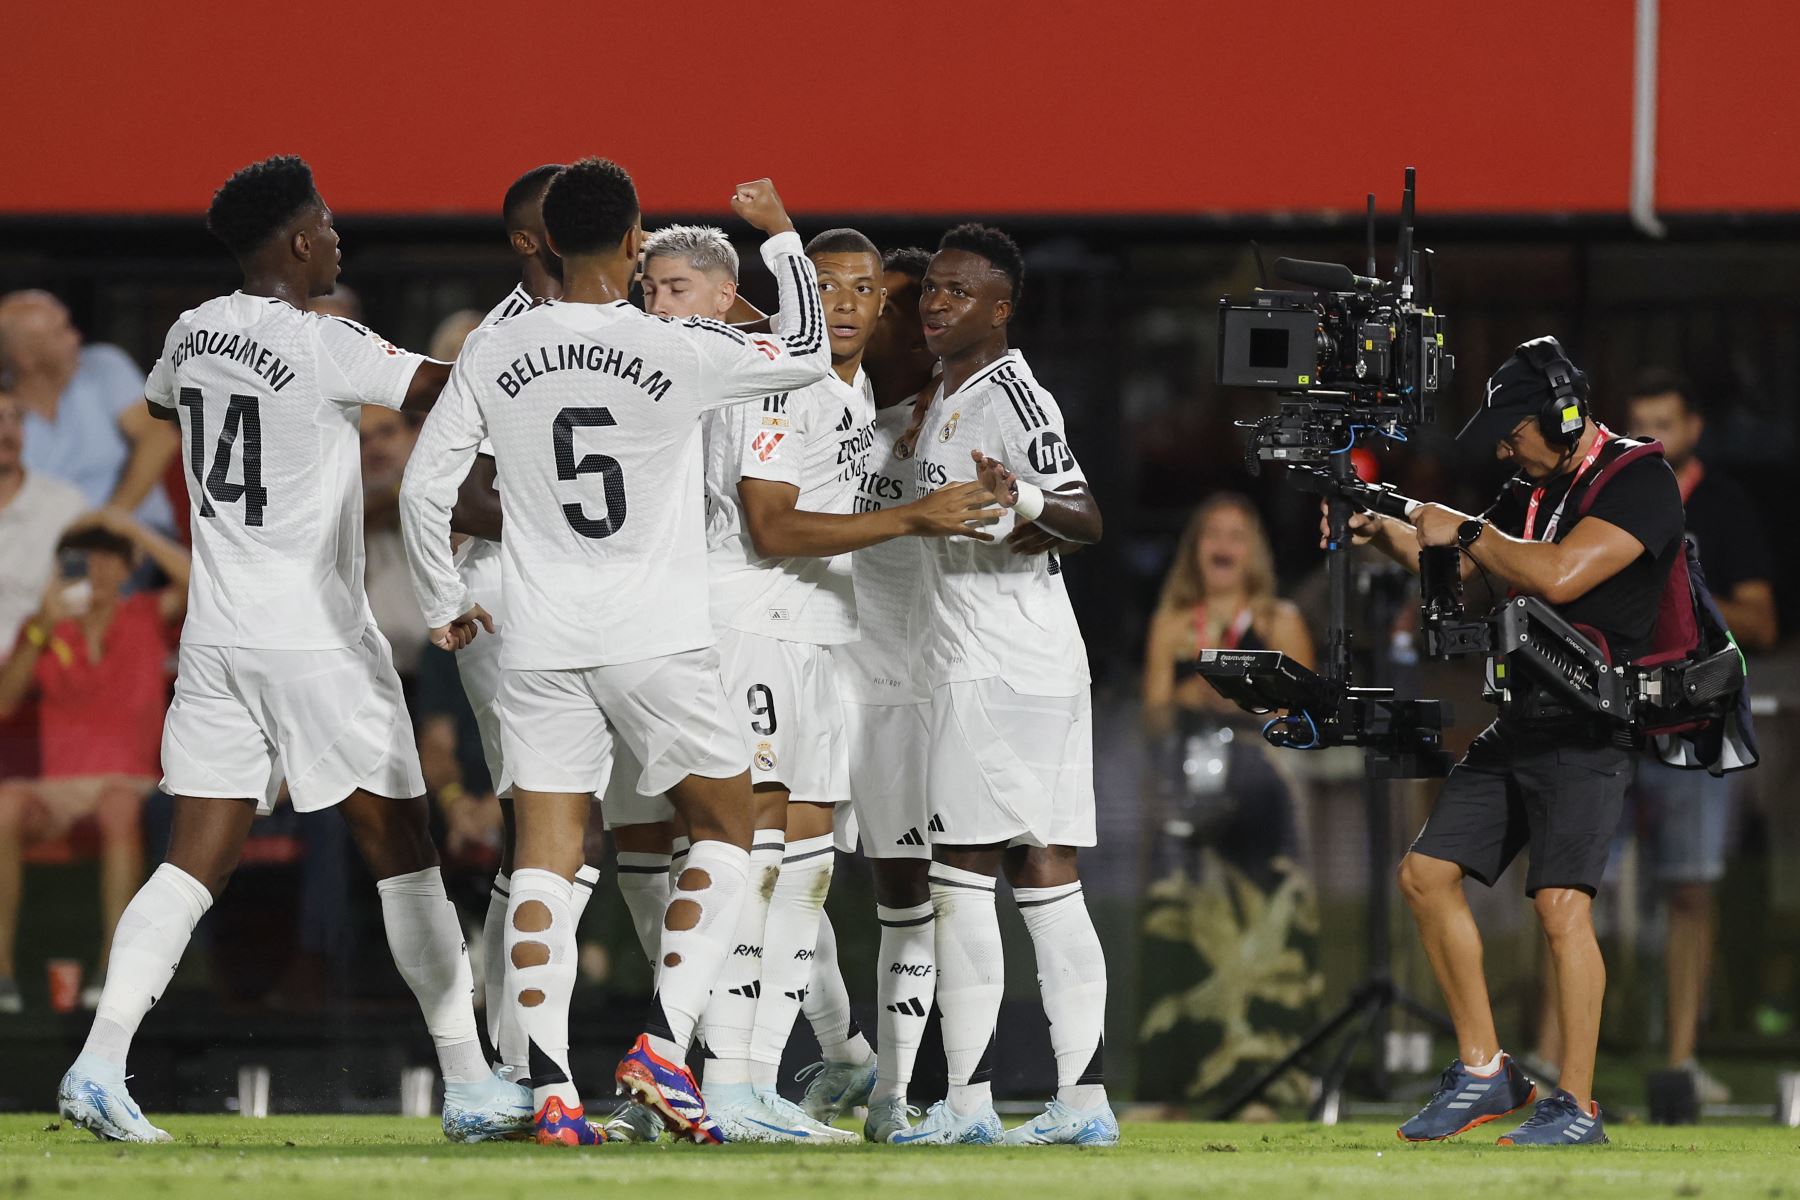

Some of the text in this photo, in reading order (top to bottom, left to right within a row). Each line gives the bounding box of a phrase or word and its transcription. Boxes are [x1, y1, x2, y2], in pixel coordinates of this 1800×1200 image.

[172, 329, 295, 392] TCHOUAMENI
[496, 344, 673, 402] BELLINGHAM
[179, 386, 267, 526] 14
[552, 406, 627, 539] 5
[1035, 432, 1069, 473] hp
[746, 683, 777, 736] 9
[889, 962, 933, 977] RMCF
